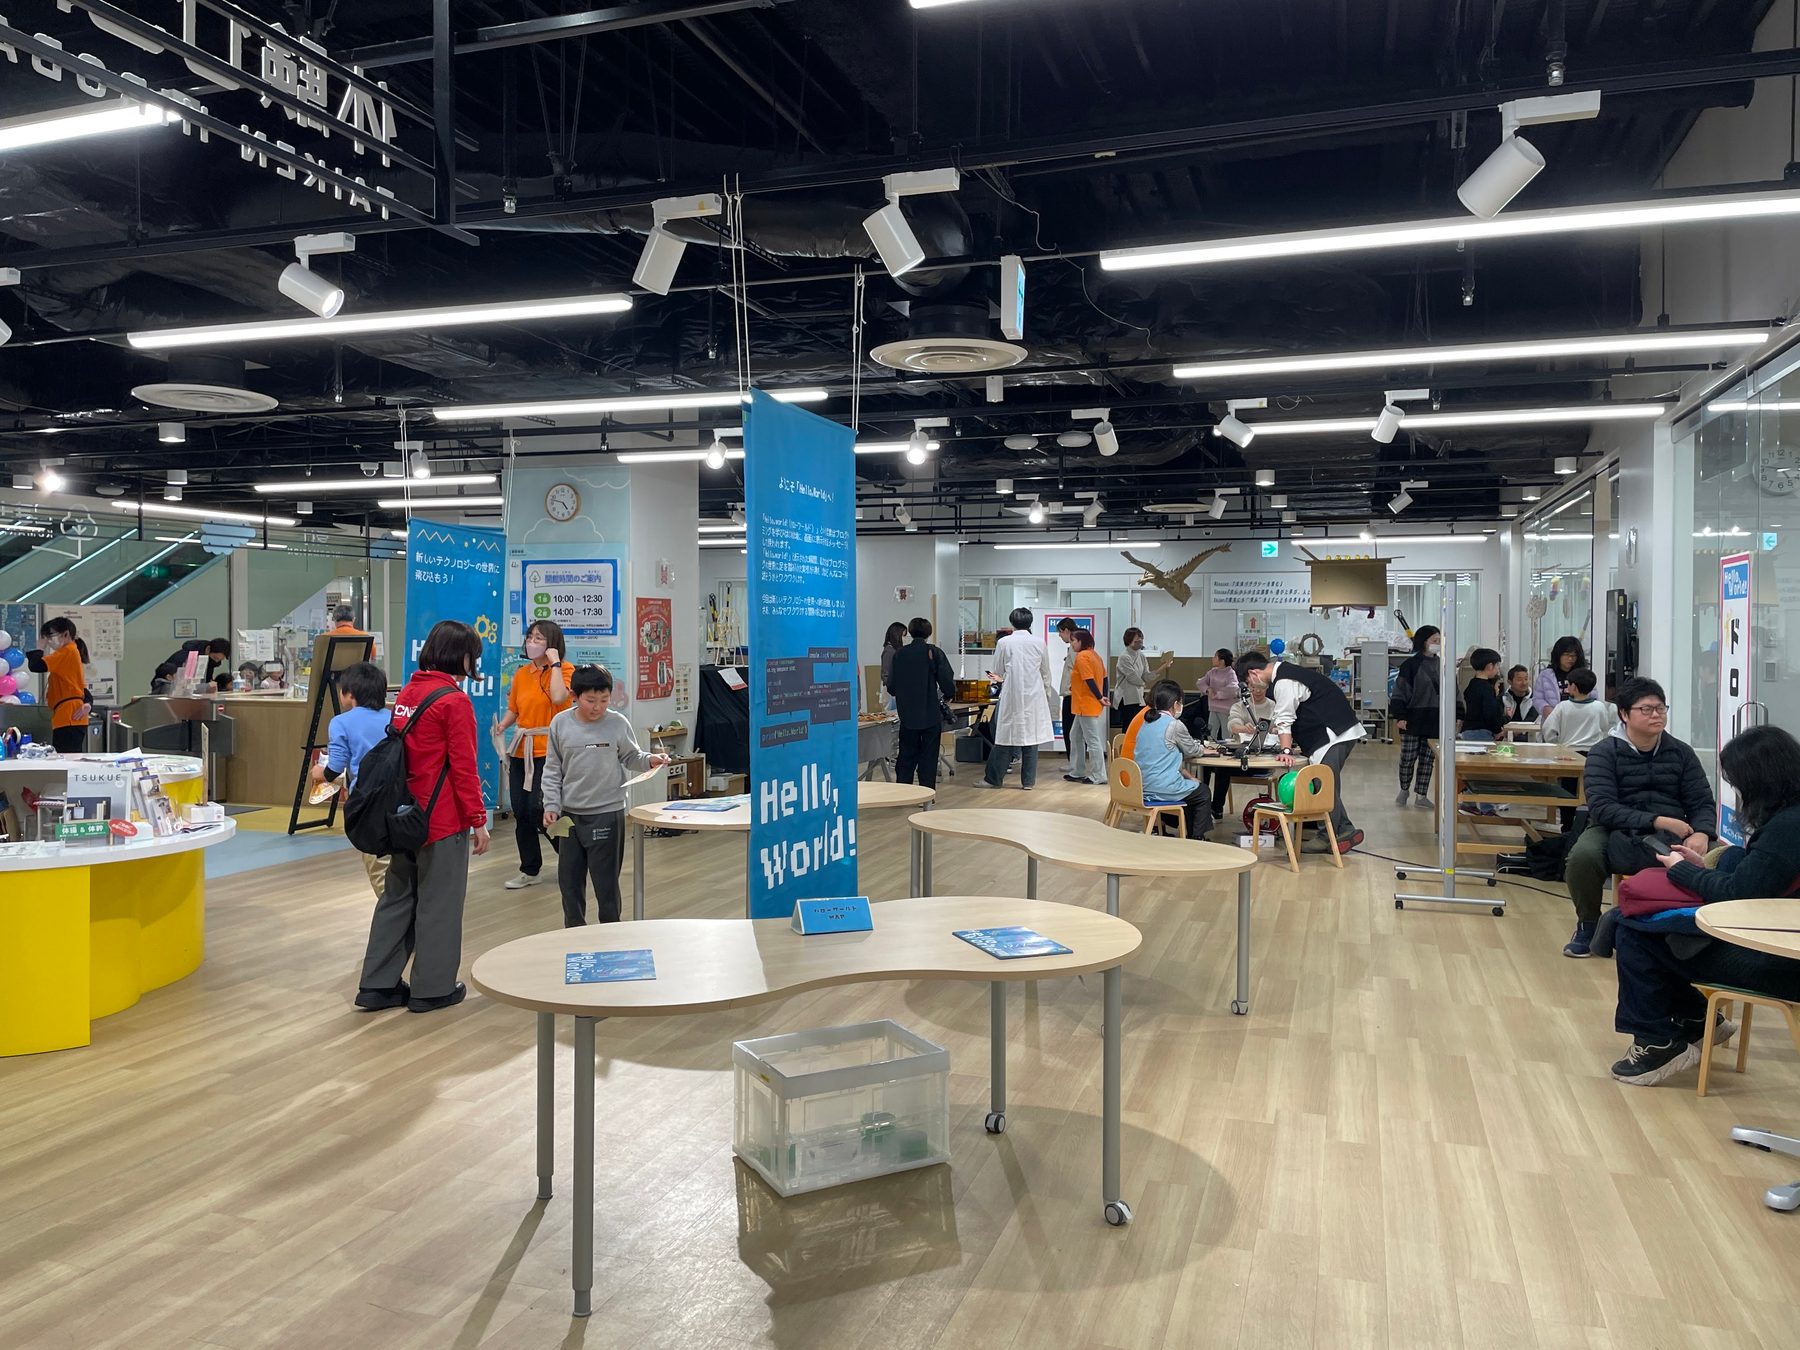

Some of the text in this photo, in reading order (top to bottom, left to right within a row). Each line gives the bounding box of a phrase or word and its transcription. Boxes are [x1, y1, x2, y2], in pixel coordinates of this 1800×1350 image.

[554, 594, 574, 603] 10:00
[582, 594, 603, 603] 12:30
[554, 608, 574, 616] 14:00
[582, 608, 603, 616] 17:30
[74, 773, 122, 782] TSUKUE
[760, 763, 839, 825] Hello,
[760, 815, 857, 890] World!
